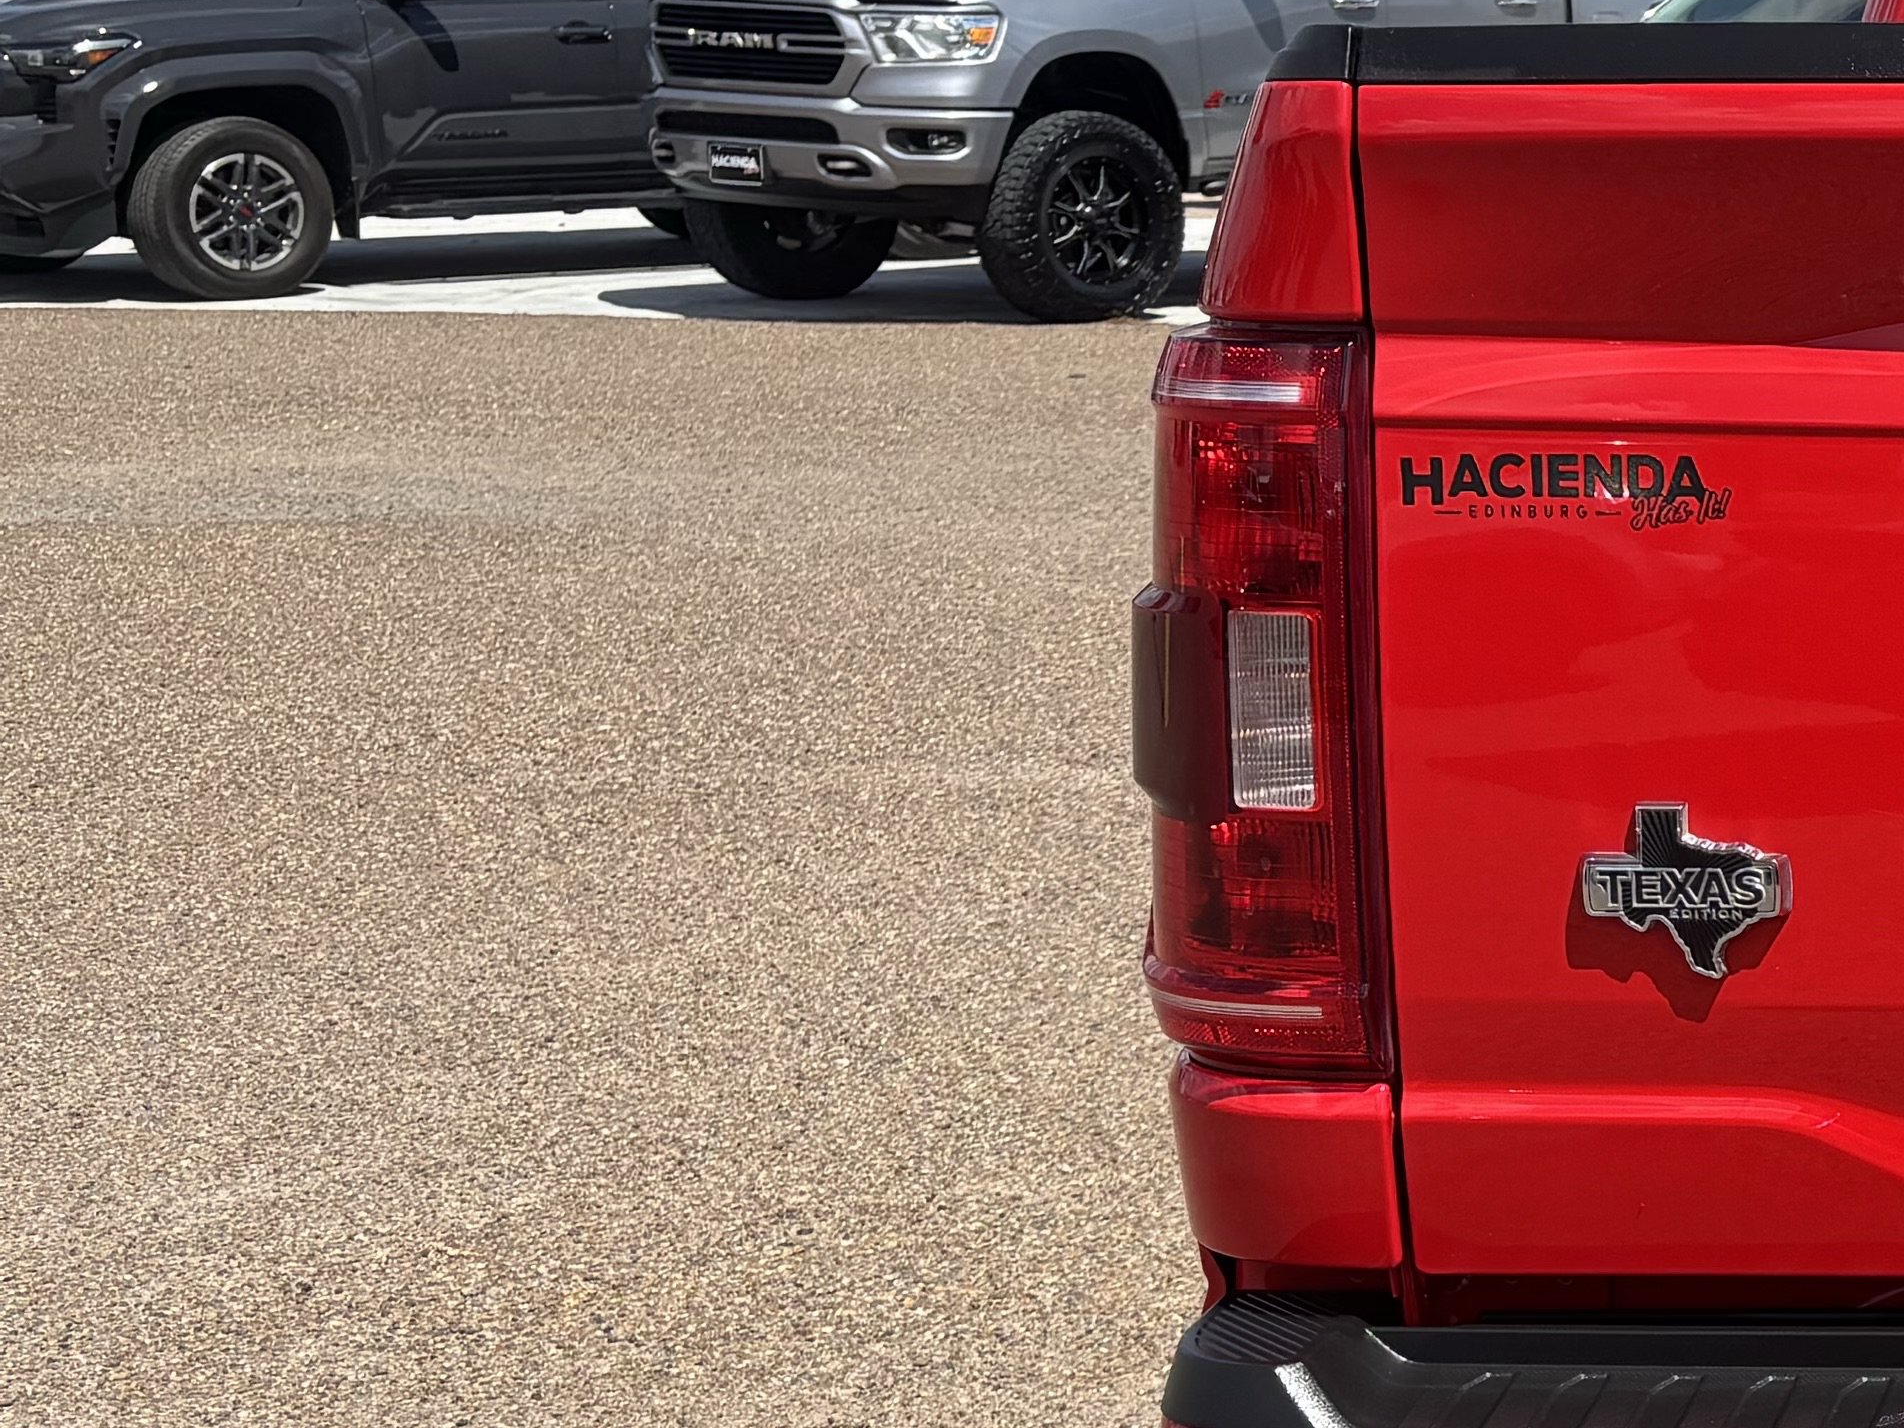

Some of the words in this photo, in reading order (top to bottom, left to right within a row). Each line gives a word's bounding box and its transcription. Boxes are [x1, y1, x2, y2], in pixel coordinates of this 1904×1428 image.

[696, 29, 774, 50] RAM
[1400, 453, 1706, 506] HACIENDA
[1468, 504, 1589, 520] EDINBURG
[1630, 494, 1694, 531] Has
[1697, 487, 1733, 524] It!
[1595, 867, 1767, 909] TEXAS
[1669, 908, 1744, 920] EDITION
